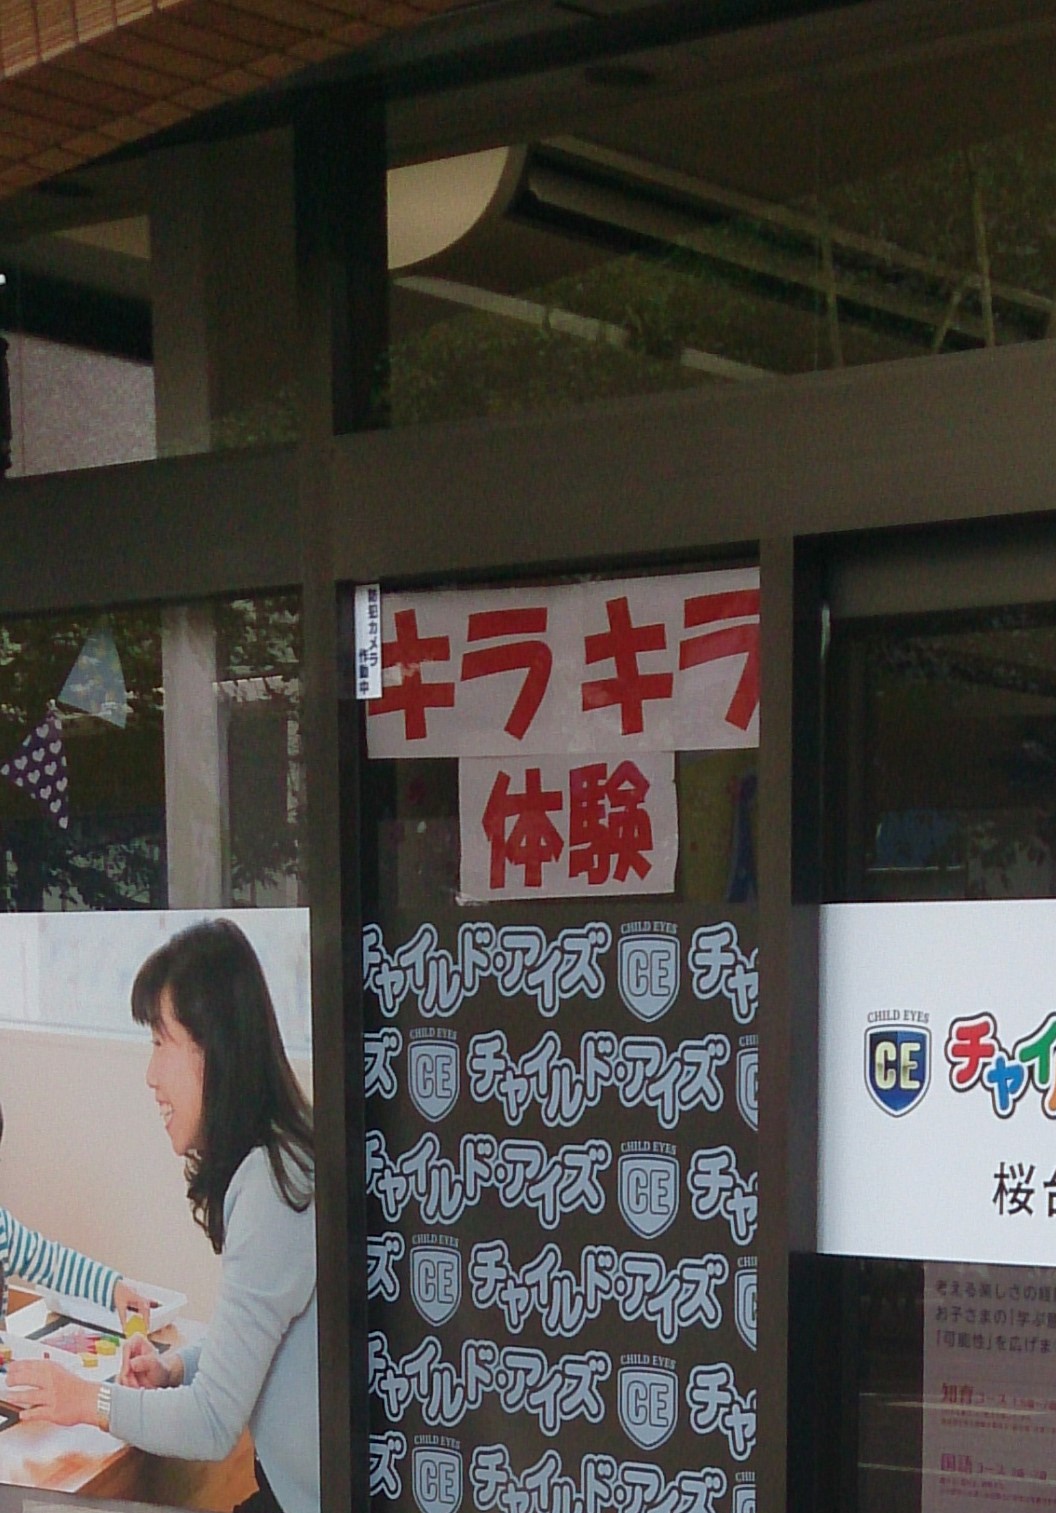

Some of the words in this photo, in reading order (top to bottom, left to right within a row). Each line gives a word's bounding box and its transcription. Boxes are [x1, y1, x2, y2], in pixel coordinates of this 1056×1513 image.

[368, 588, 760, 741] キラキラ
[481, 760, 653, 890] 体験
[620, 922, 650, 935] CHILD
[652, 922, 679, 935] EYES
[627, 949, 671, 997] CE
[409, 1026, 434, 1041] CHILD
[436, 1026, 458, 1041] EYES
[867, 1009, 899, 1024] CHILD
[903, 1009, 930, 1024] EYES
[416, 1053, 453, 1098] CE
[874, 1040, 922, 1091] CE
[620, 1140, 649, 1155] CHILD
[651, 1140, 677, 1155] EYES
[627, 1167, 670, 1214] CE
[411, 1233, 436, 1248] CHILD
[437, 1233, 459, 1248] EYES
[418, 1257, 454, 1304] CE
[620, 1353, 649, 1369] CHILD
[651, 1353, 677, 1369] EYES
[627, 1381, 669, 1428] CE
[413, 1434, 437, 1450] CHILD
[438, 1434, 460, 1450] EYES
[419, 1458, 456, 1504] CE
